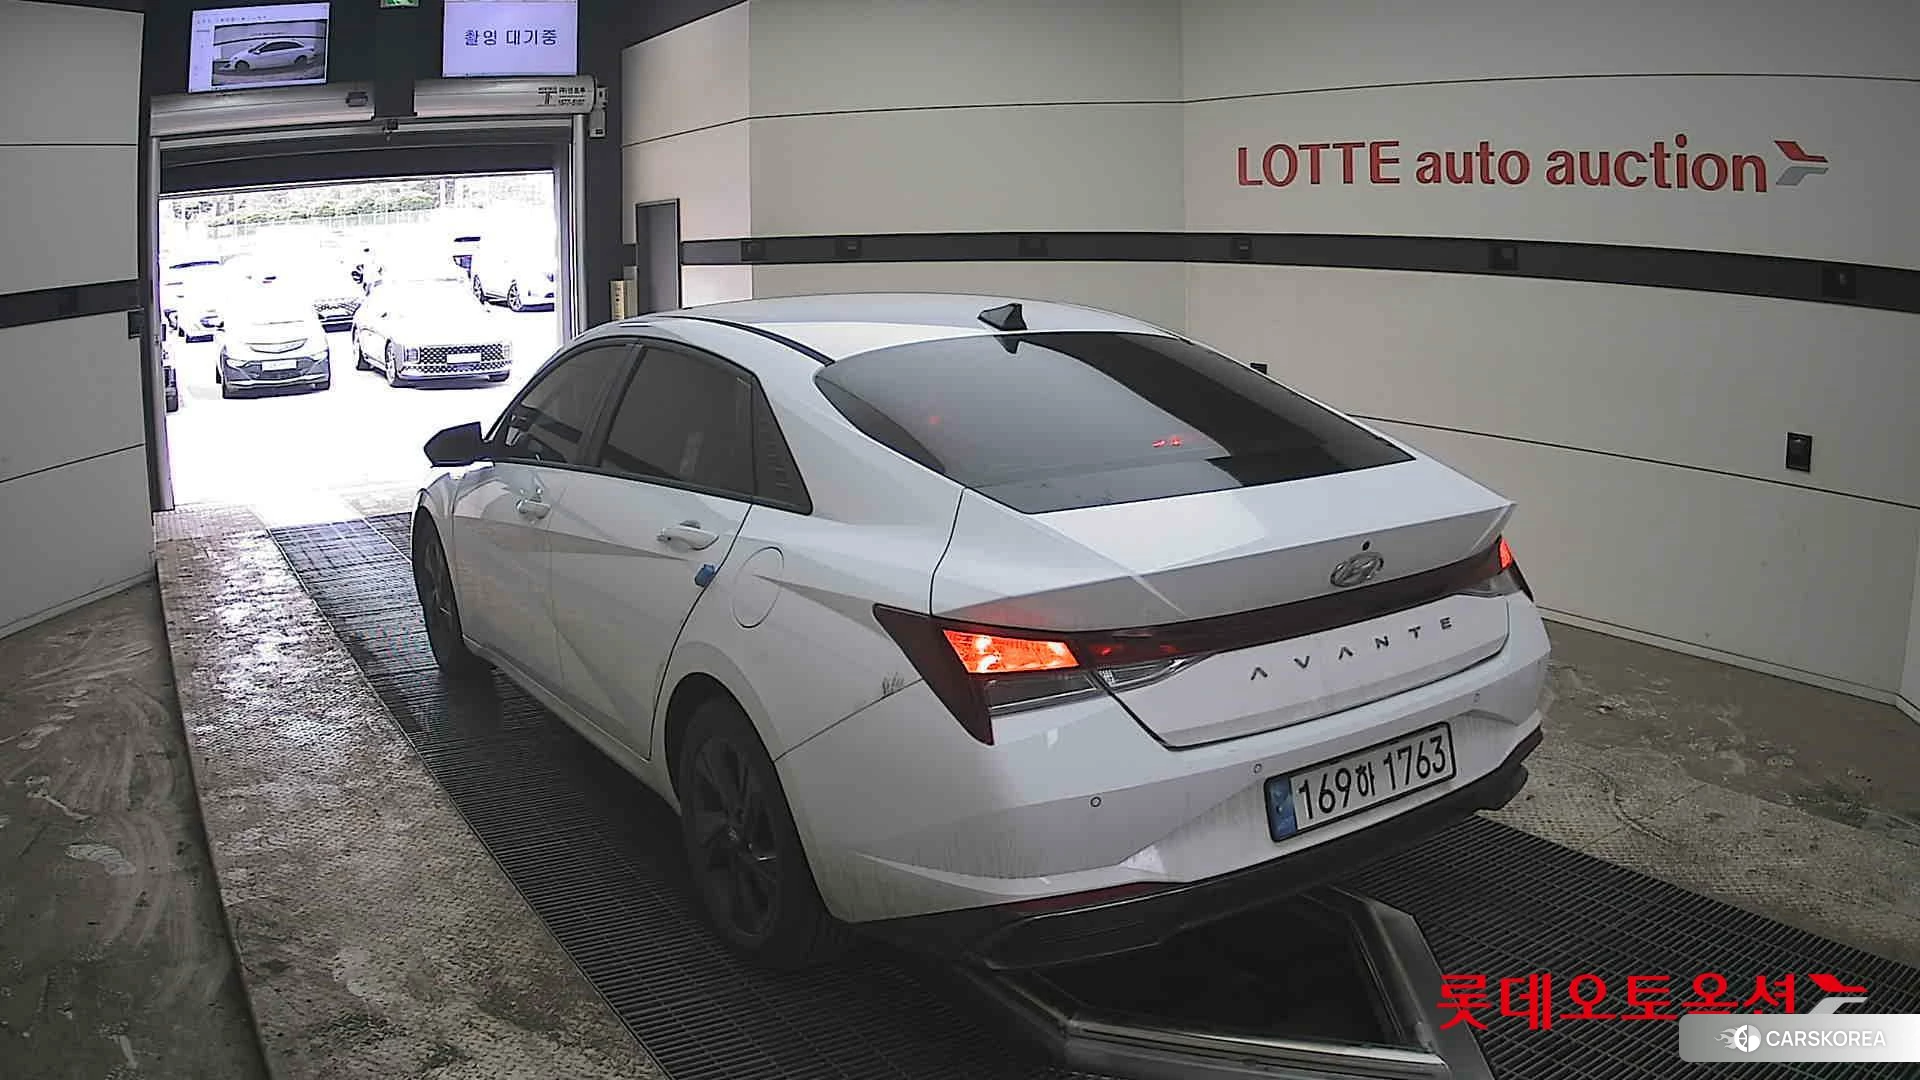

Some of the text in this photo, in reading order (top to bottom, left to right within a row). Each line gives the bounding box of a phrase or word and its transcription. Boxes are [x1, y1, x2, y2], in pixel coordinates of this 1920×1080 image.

[464, 29, 557, 46] 촬영 대기중
[1238, 133, 1768, 193] LOTTE auto auction
[1250, 616, 1453, 681] AVANTE
[1298, 735, 1447, 819] 169하 1763
